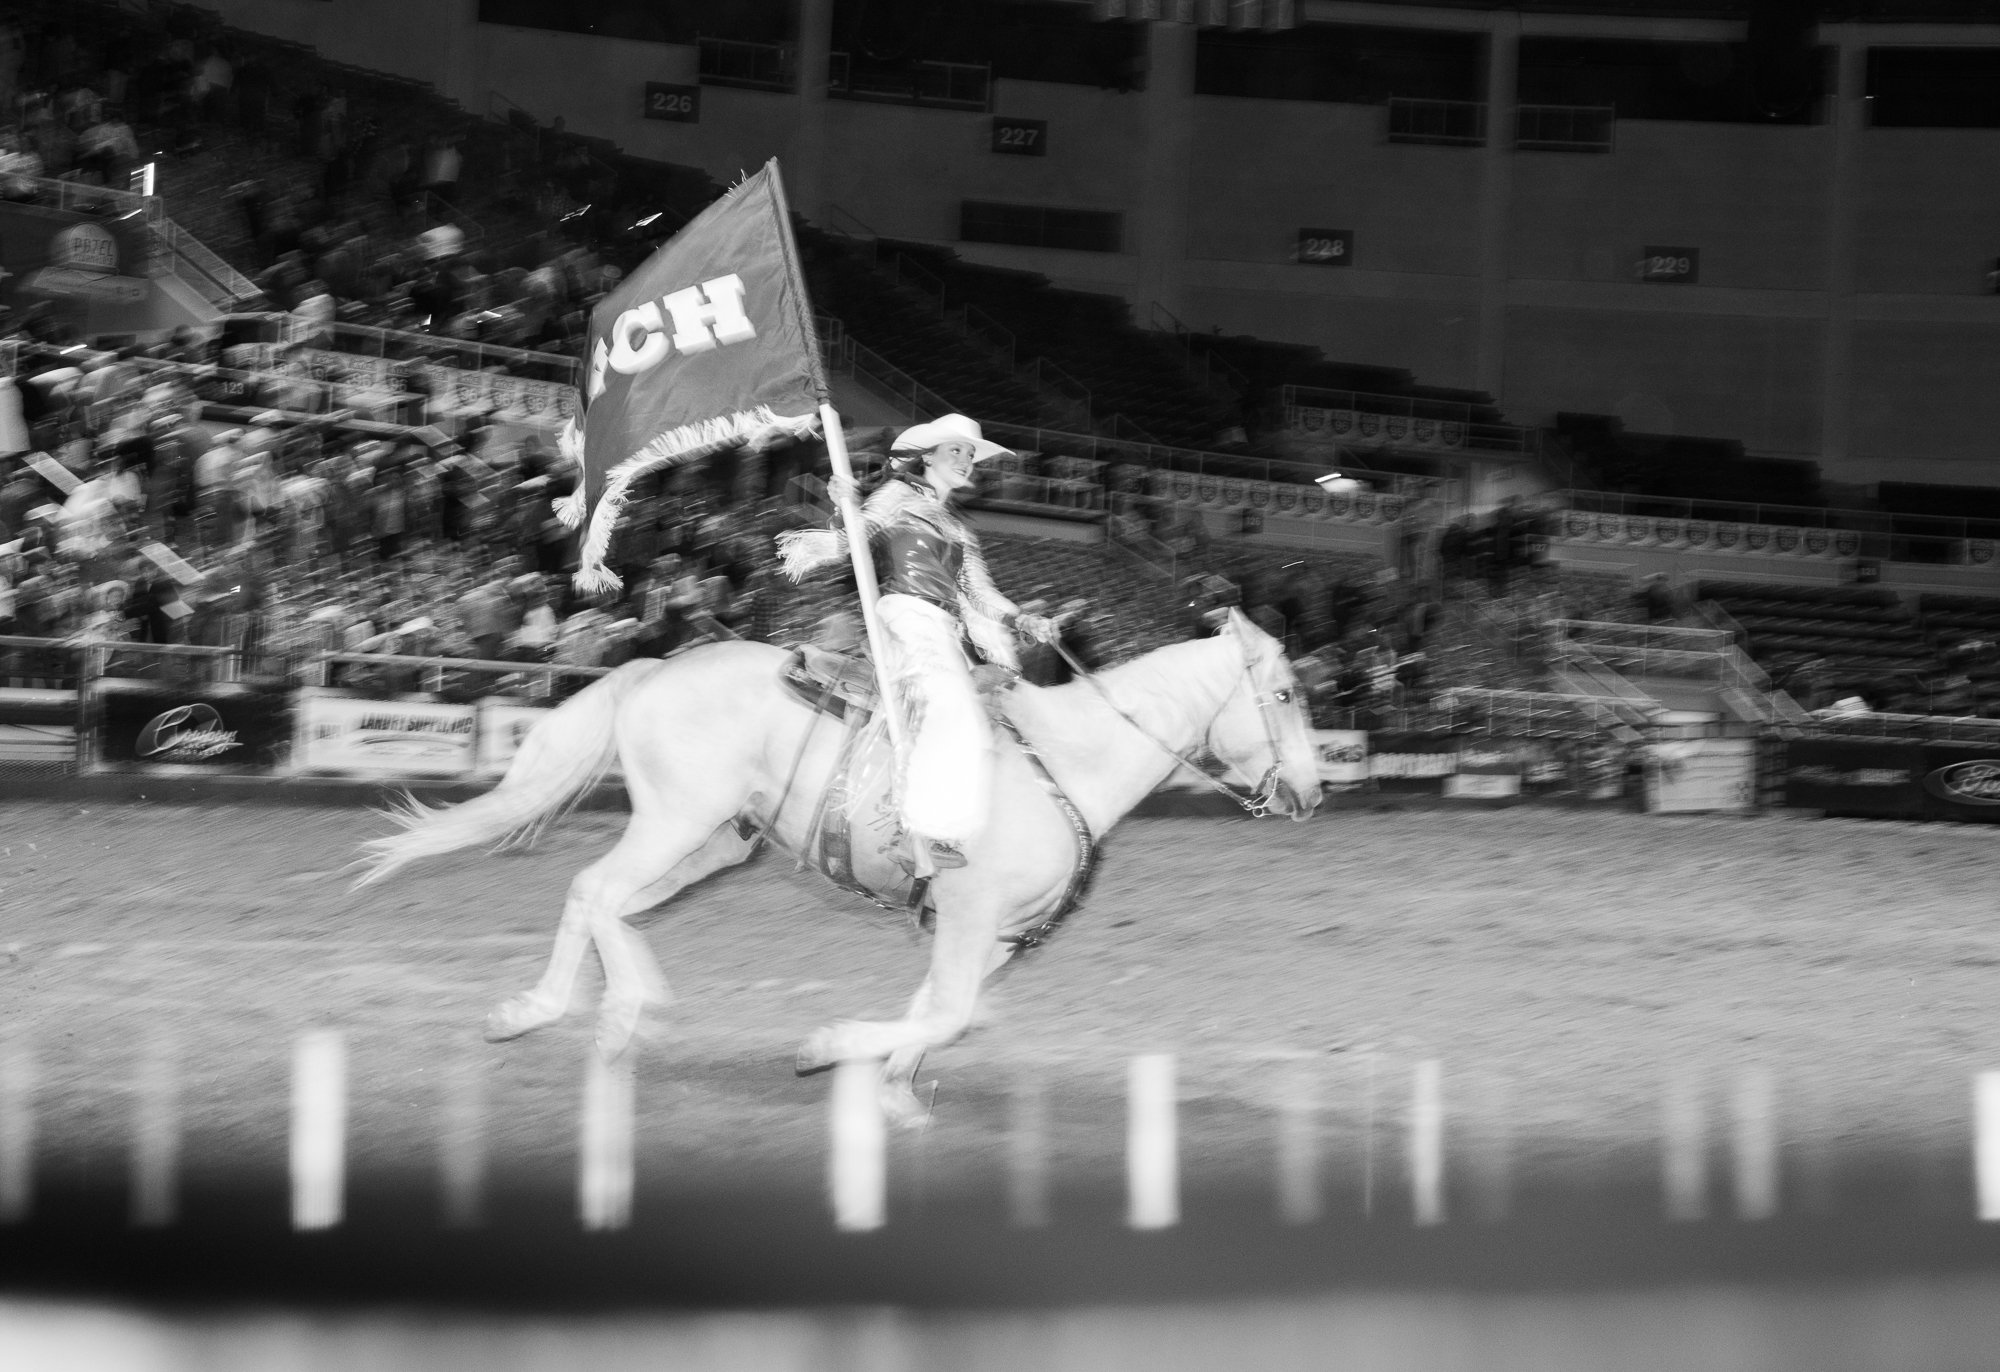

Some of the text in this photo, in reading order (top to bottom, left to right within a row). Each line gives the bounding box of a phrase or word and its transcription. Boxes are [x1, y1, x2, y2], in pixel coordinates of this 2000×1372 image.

[652, 92, 692, 113] 226
[999, 126, 1039, 146] 227
[1306, 238, 1345, 257] 228
[1652, 256, 1690, 274] 229
[223, 381, 245, 394] 123
[359, 714, 406, 731] LANDRY
